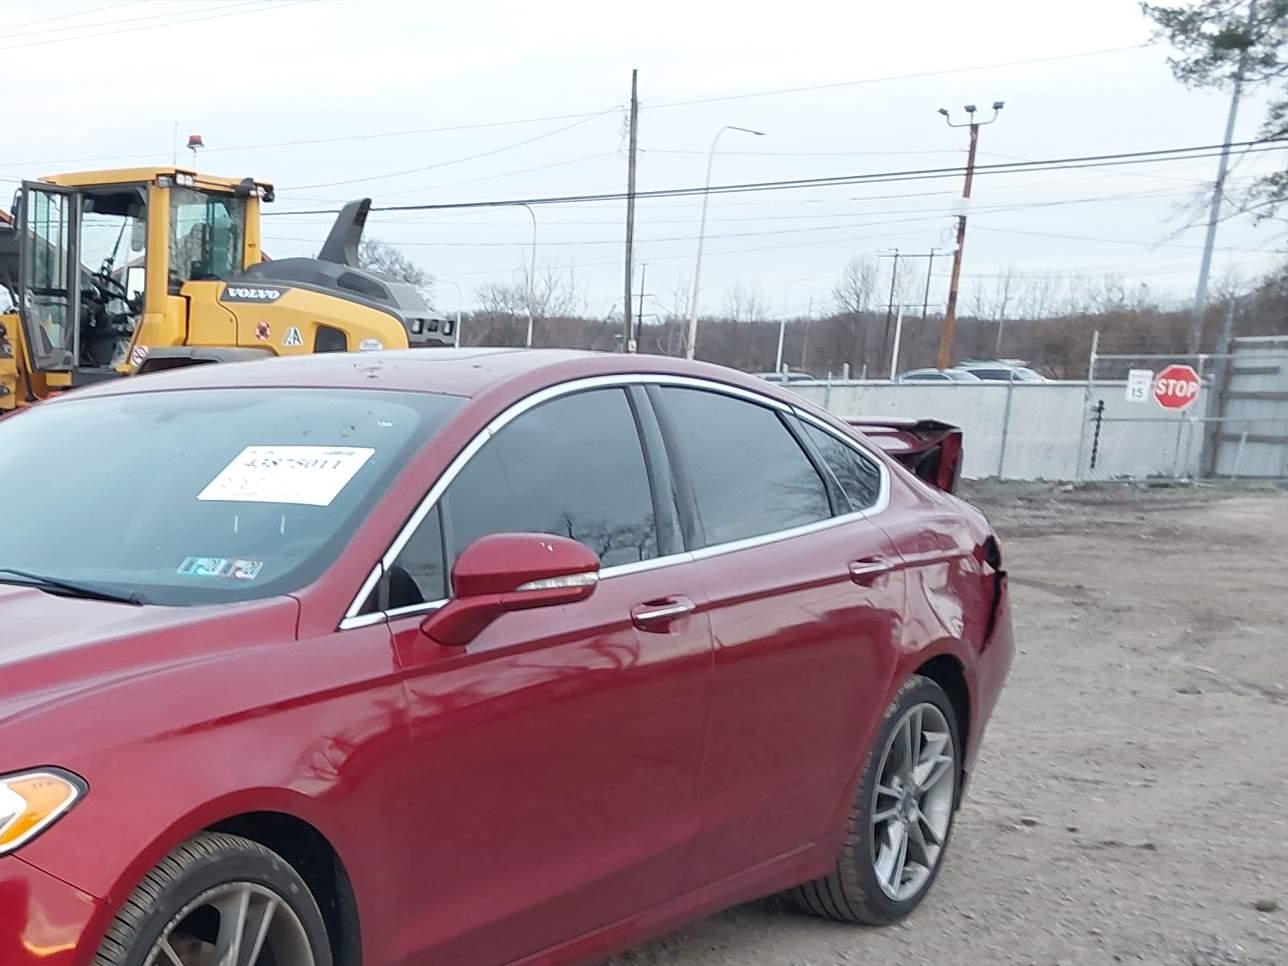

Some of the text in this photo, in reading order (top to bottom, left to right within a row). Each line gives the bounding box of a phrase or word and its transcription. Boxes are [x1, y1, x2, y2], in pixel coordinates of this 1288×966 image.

[227, 287, 281, 300] VOLVO
[1132, 387, 1144, 398] 15
[1156, 378, 1198, 398] STOP
